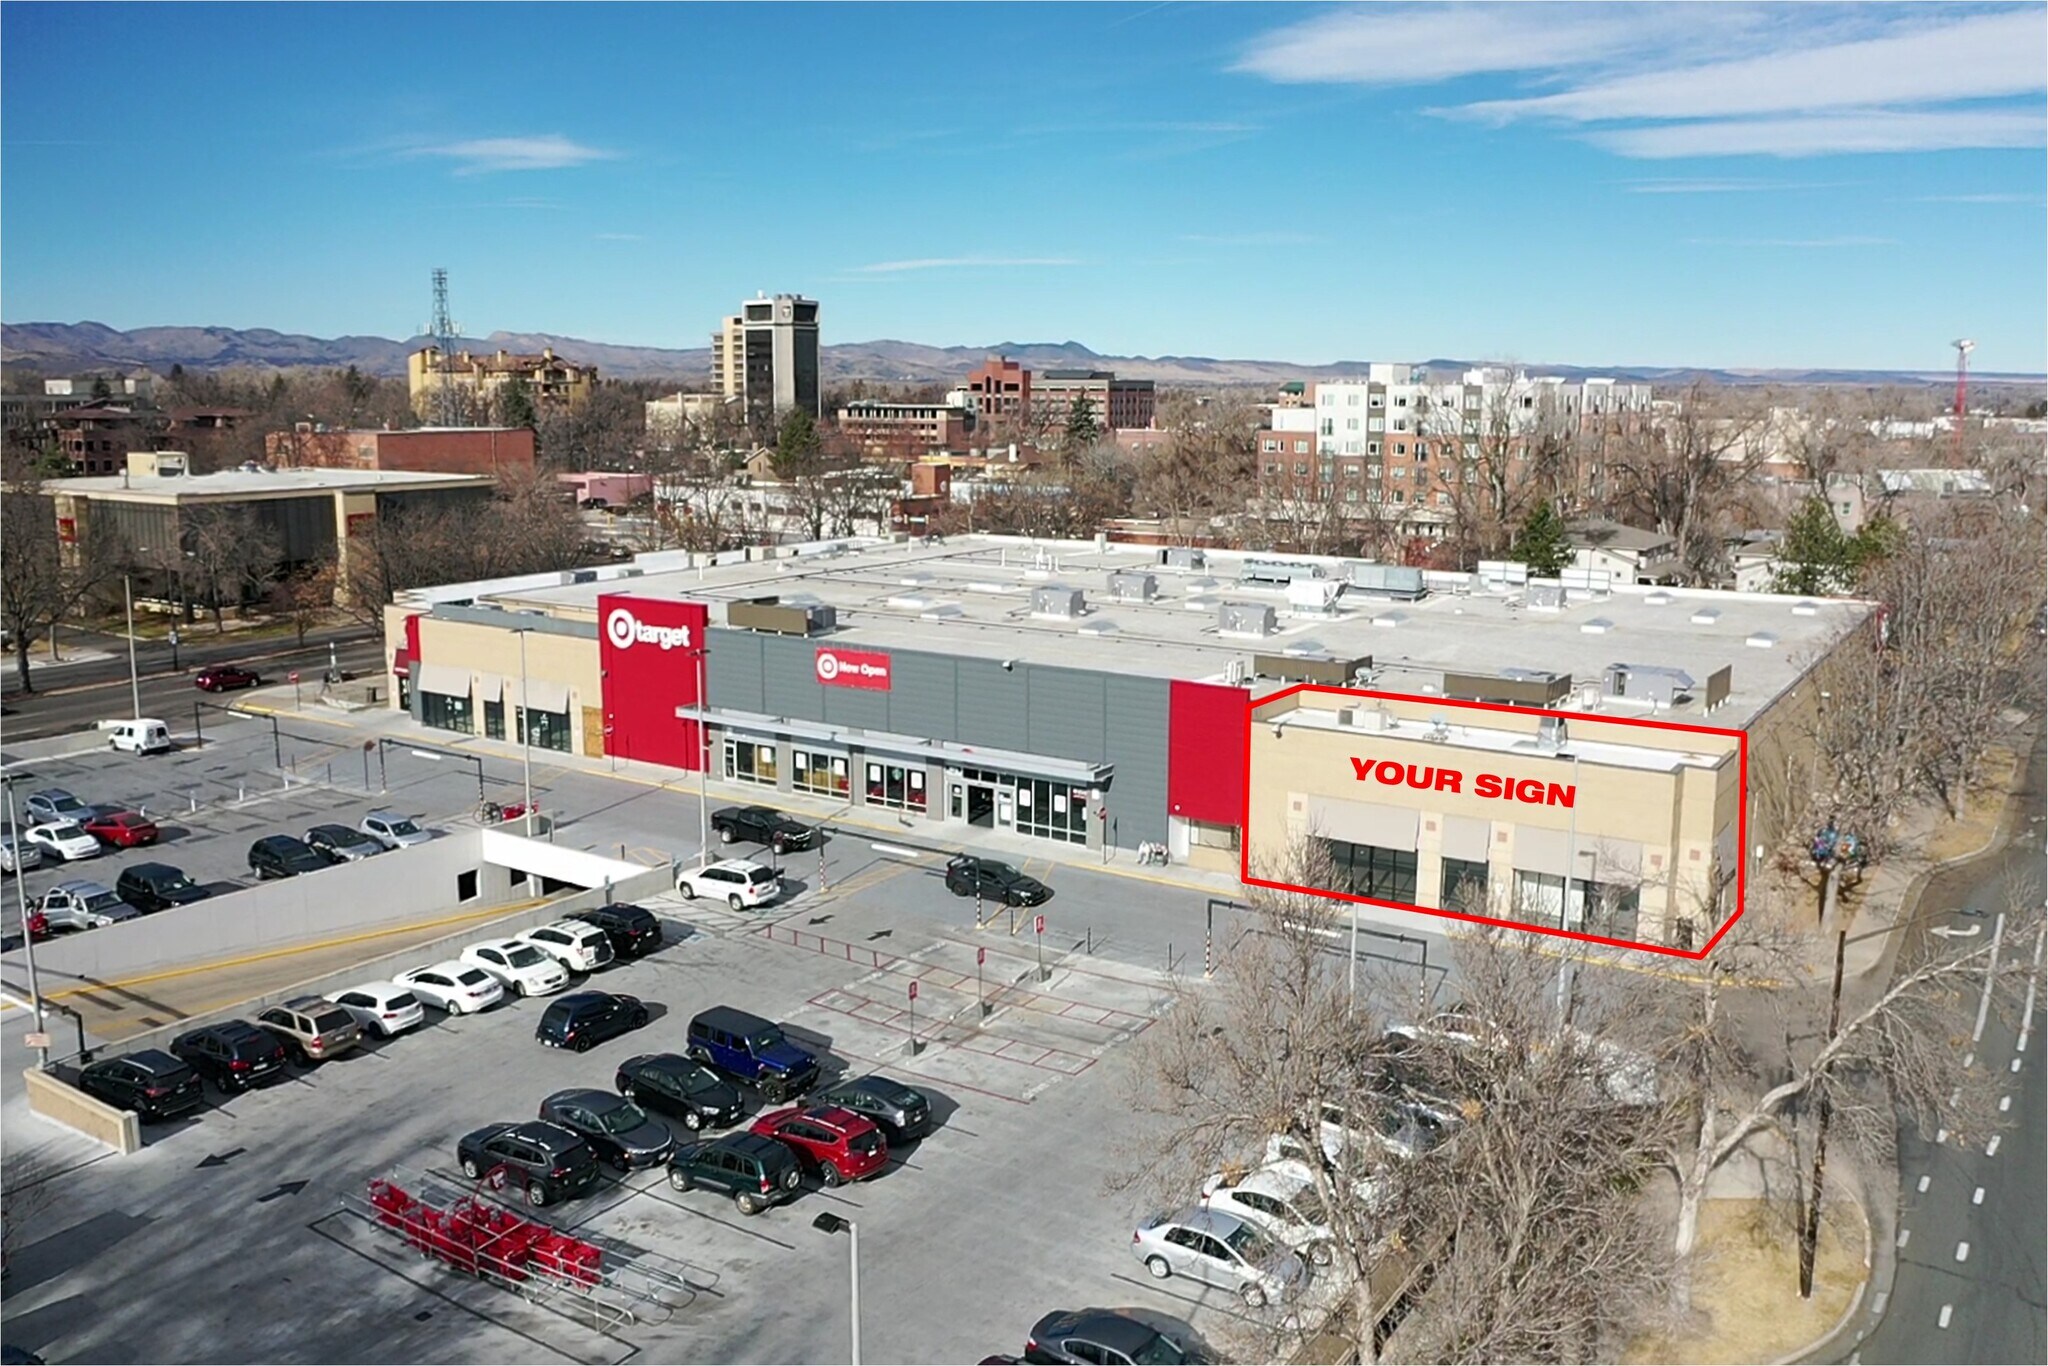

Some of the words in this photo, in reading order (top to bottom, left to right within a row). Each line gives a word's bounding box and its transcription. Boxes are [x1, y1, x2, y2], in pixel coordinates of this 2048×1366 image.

[636, 619, 690, 650] target
[839, 660, 859, 674] Now
[860, 663, 887, 677] Open
